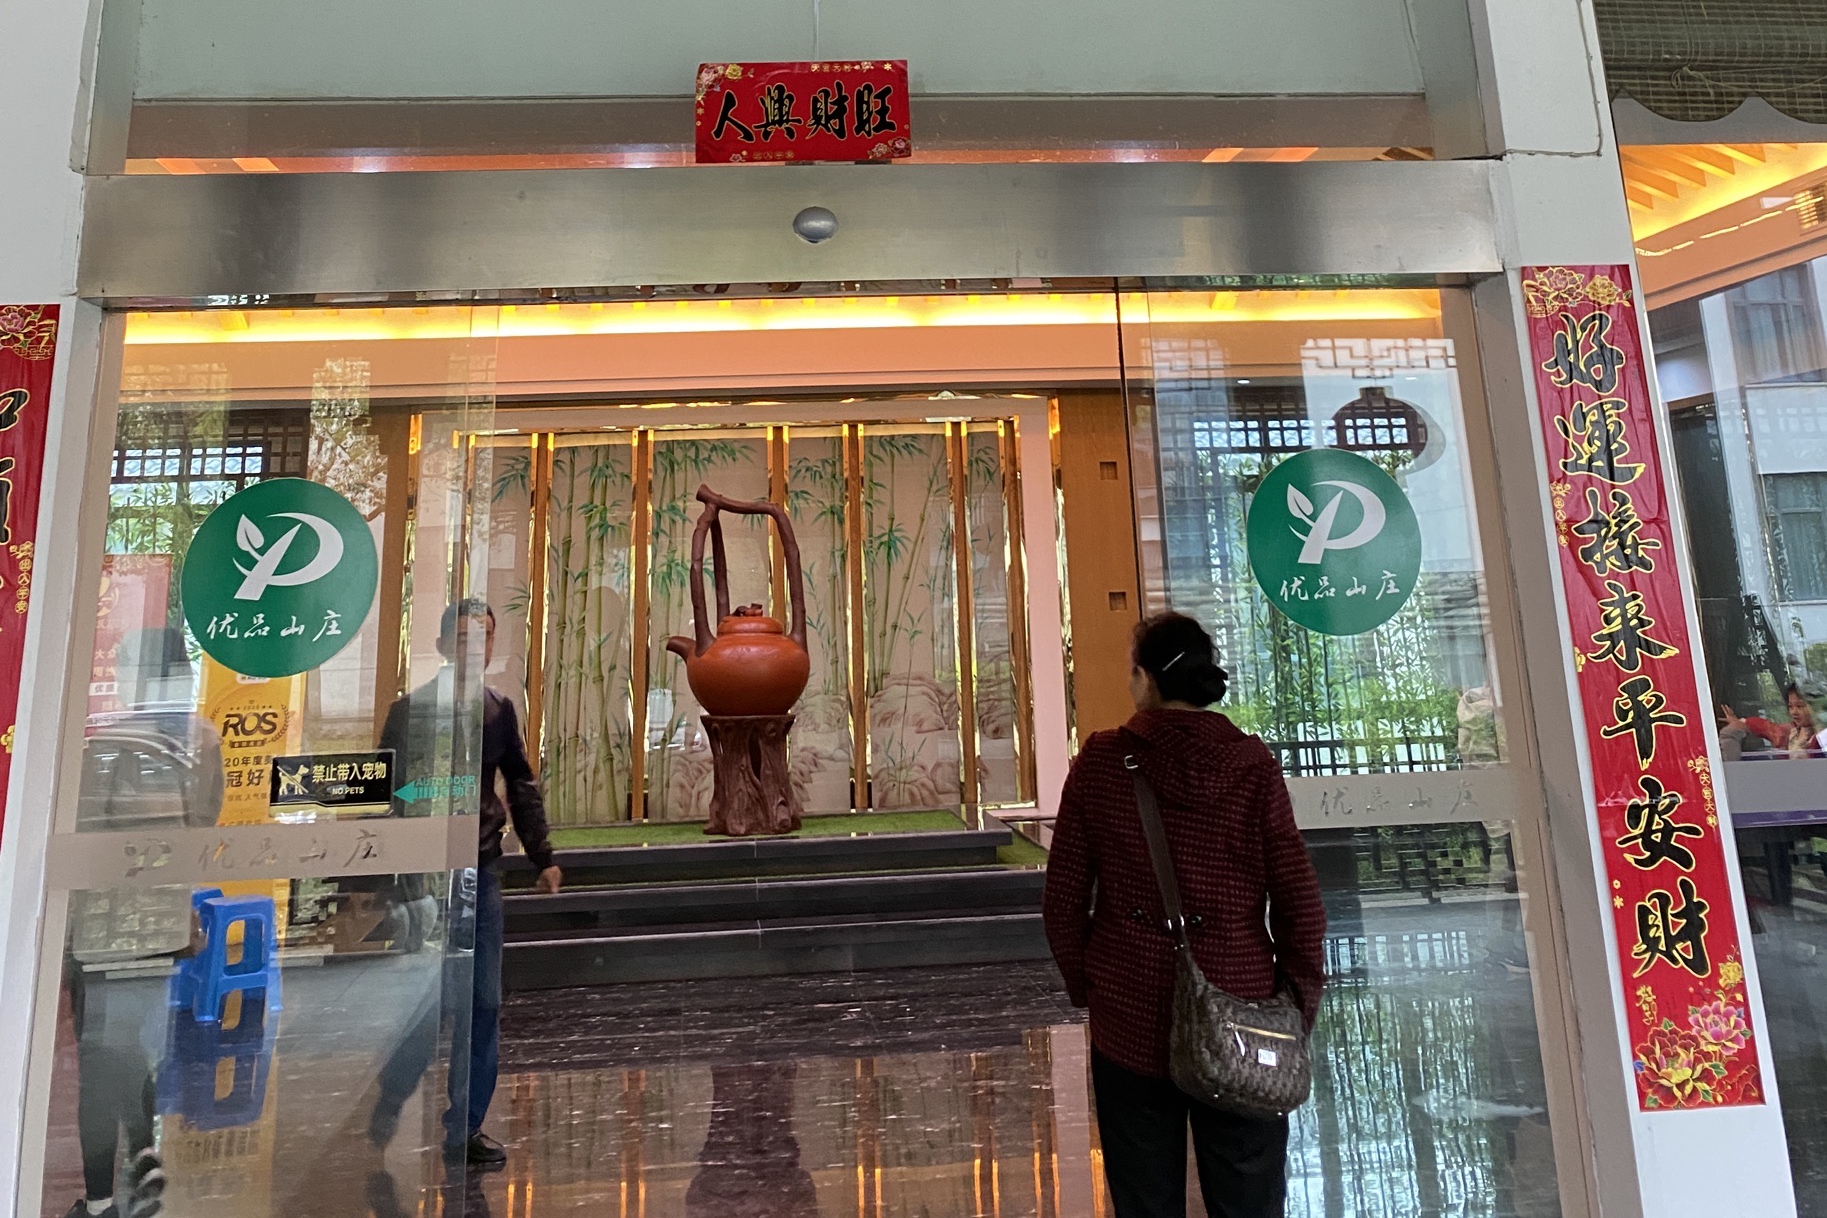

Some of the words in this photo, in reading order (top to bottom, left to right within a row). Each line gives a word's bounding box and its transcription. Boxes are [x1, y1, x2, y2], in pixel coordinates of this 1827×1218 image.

[711, 80, 897, 143] 人興財旺
[1280, 569, 1400, 603] 优品山庄
[206, 609, 342, 643] 优品山庄
[221, 711, 279, 738] ROS
[312, 761, 386, 783] 禁止带入宠物
[345, 786, 364, 795] PETS
